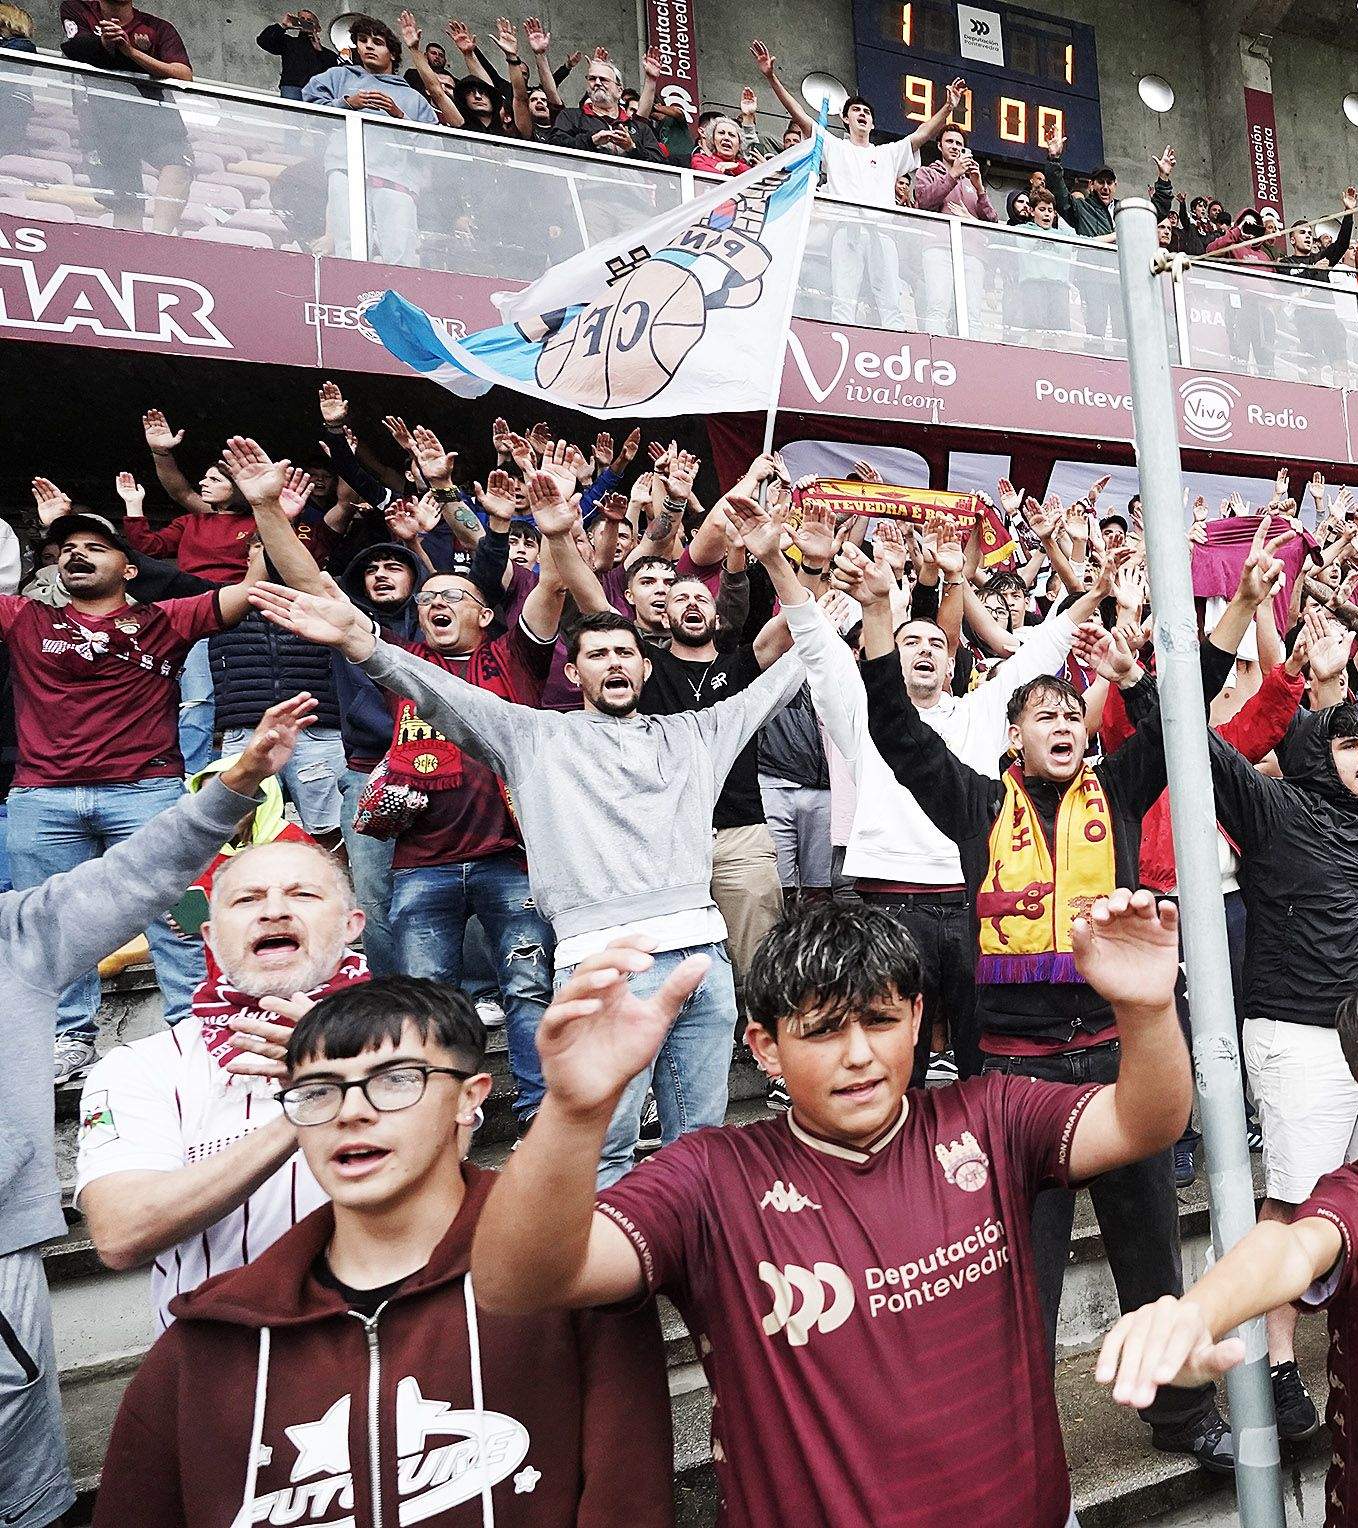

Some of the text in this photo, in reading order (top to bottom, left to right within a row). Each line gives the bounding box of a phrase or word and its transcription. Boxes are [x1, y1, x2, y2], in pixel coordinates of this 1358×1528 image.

[653, 0, 676, 76] Deputaci
[672, 0, 692, 80] Ponteved
[902, 2, 912, 47] 1
[963, 33, 999, 46] Deputación
[964, 40, 1000, 52] Pontevedra
[1065, 44, 1074, 85] 1
[1251, 124, 1268, 200] Deputación
[1264, 127, 1279, 203] Pontevedra
[1035, 379, 1308, 430] Ponteve Viva Radio
[865, 1217, 1005, 1290] Deputación
